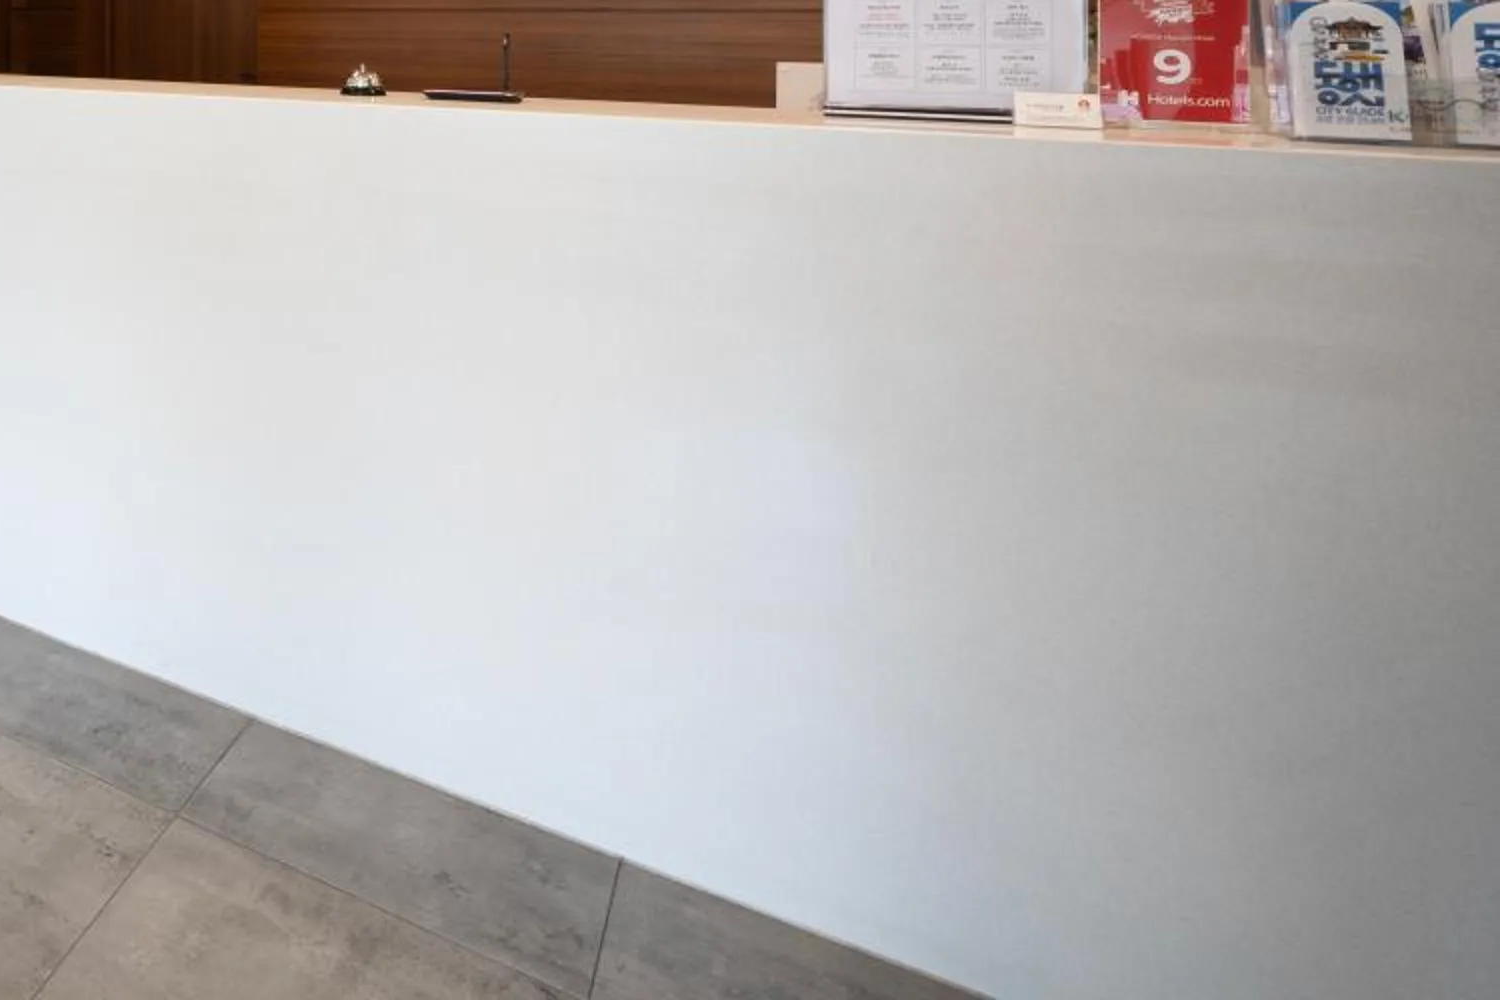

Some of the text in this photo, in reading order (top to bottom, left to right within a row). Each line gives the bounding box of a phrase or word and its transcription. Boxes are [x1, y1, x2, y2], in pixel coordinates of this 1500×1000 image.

[1153, 48, 1192, 85] 9
[1147, 93, 1231, 109] Hotels.com
[1315, 106, 1342, 115] CITY
